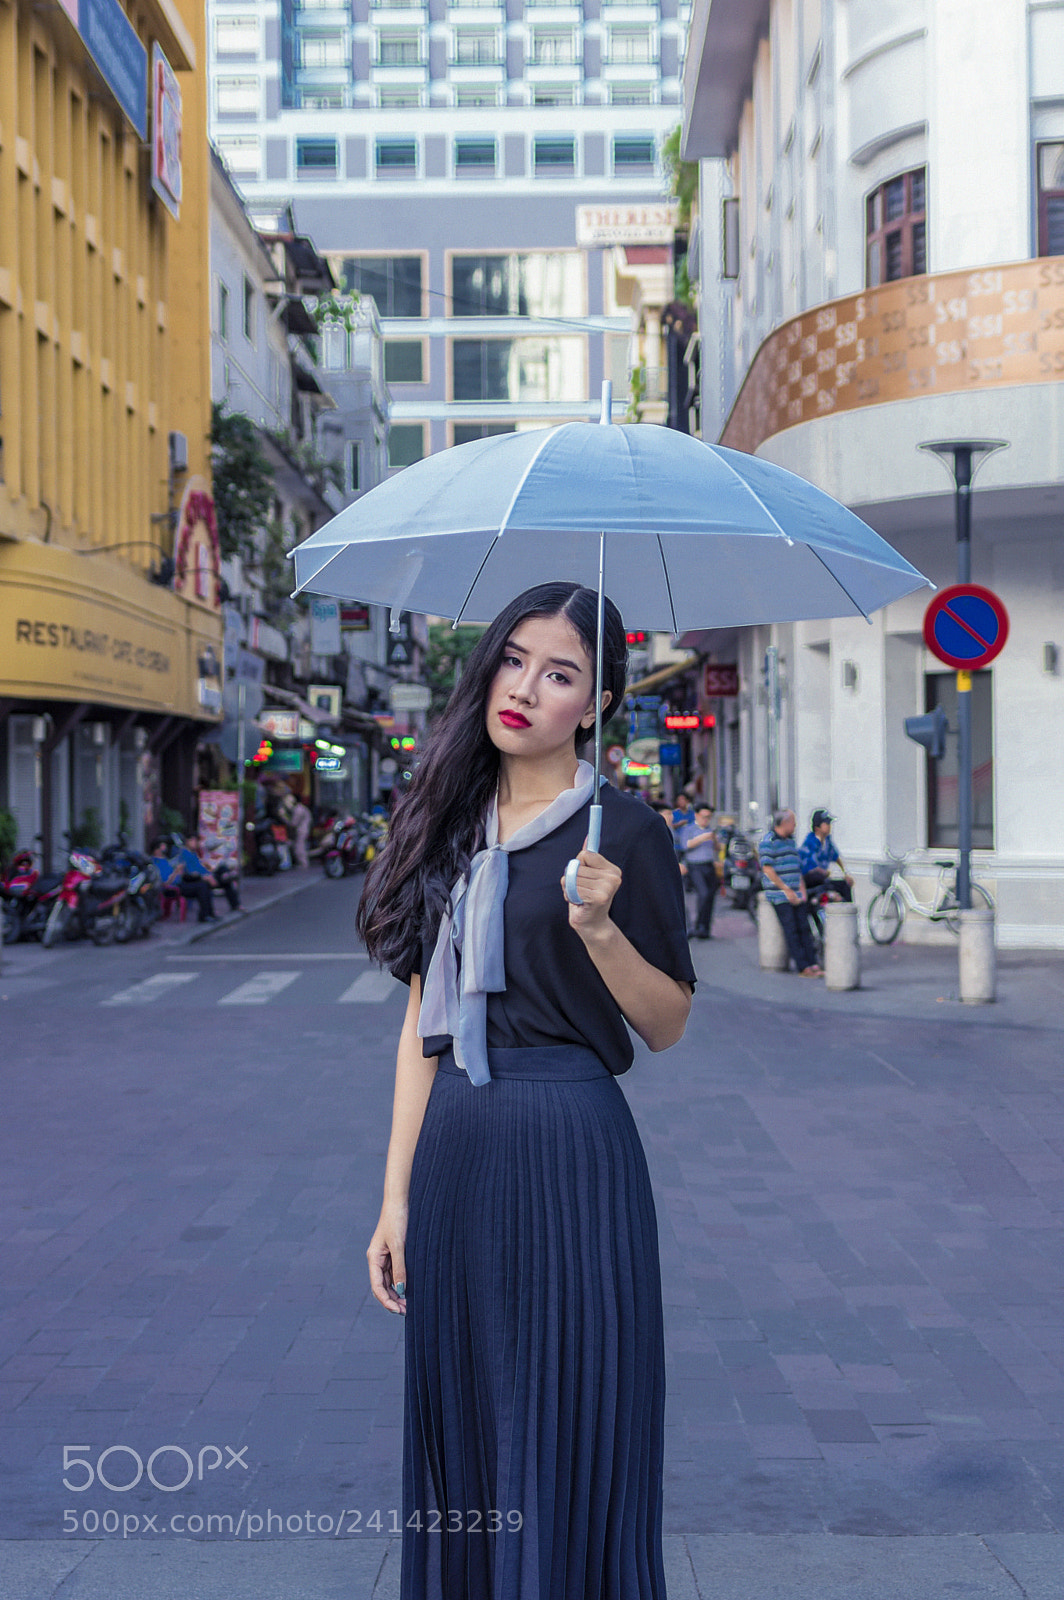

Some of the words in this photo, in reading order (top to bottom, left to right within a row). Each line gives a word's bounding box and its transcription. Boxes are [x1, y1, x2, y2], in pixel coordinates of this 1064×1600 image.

[907, 282, 936, 306] SSI
[968, 271, 1003, 297] SSI
[936, 297, 968, 325] SSI
[1002, 289, 1039, 315] SSI
[836, 321, 858, 349] SSI
[907, 324, 936, 348] SSI
[968, 313, 1003, 341] SSI
[936, 339, 968, 366] SSI
[1002, 331, 1038, 357] SSI
[908, 366, 937, 390] SSI
[970, 356, 1003, 381] SSI
